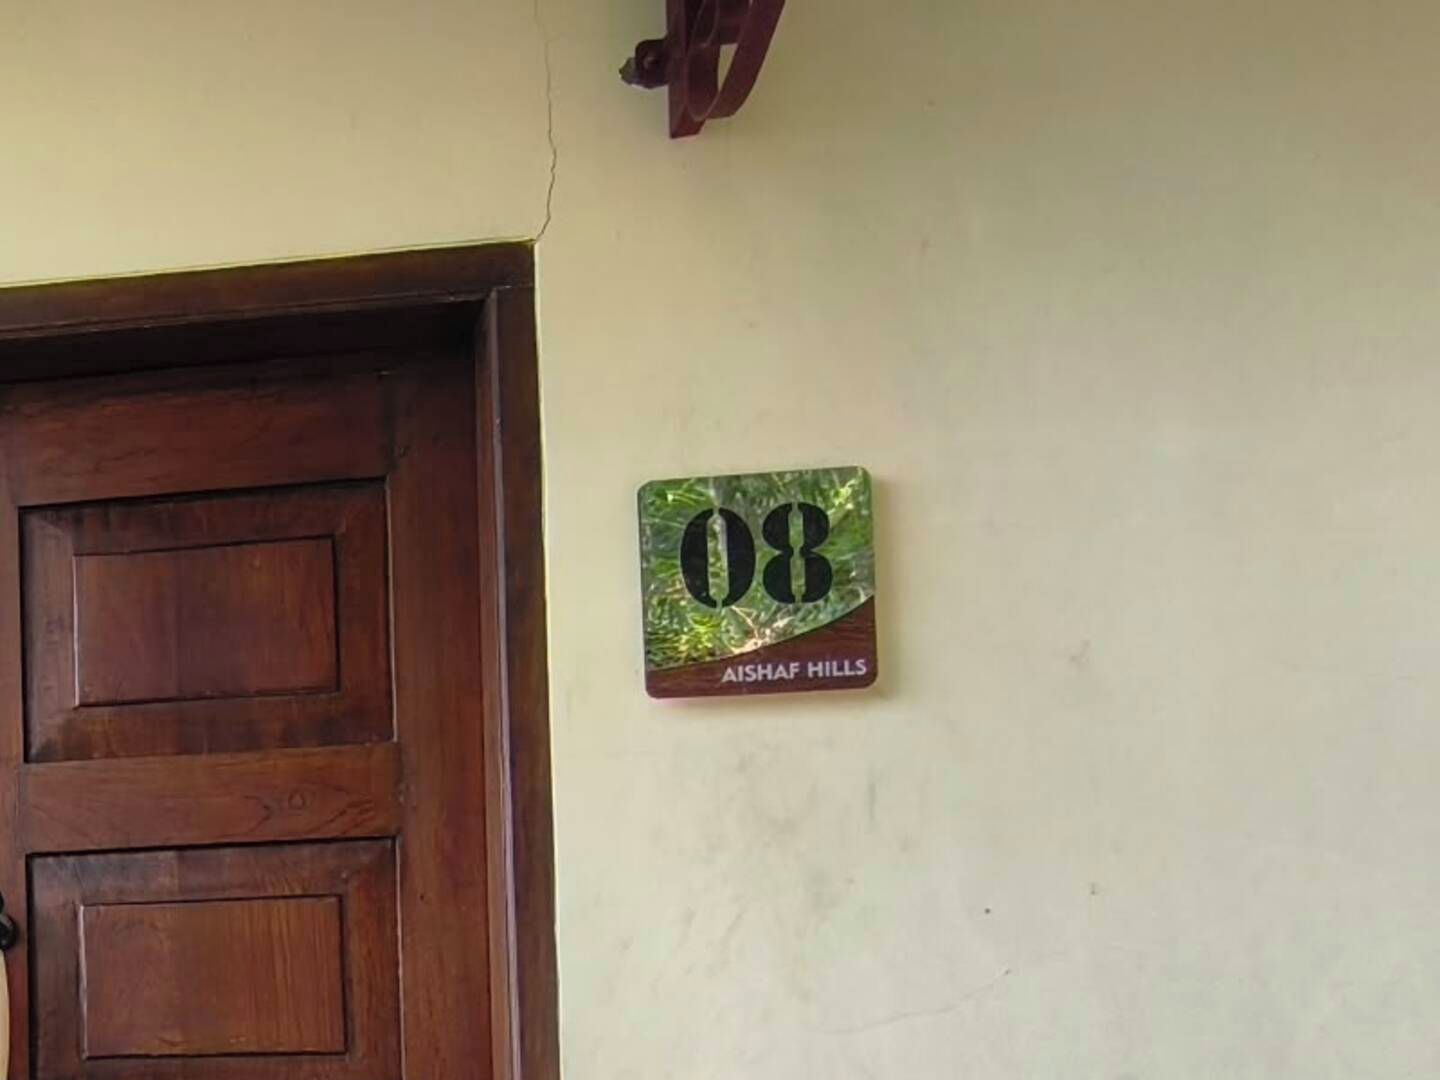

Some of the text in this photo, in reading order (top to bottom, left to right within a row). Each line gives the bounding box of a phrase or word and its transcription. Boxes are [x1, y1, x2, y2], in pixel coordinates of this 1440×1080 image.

[680, 502, 833, 608] 08
[721, 659, 867, 683] AISHAF HILLS
